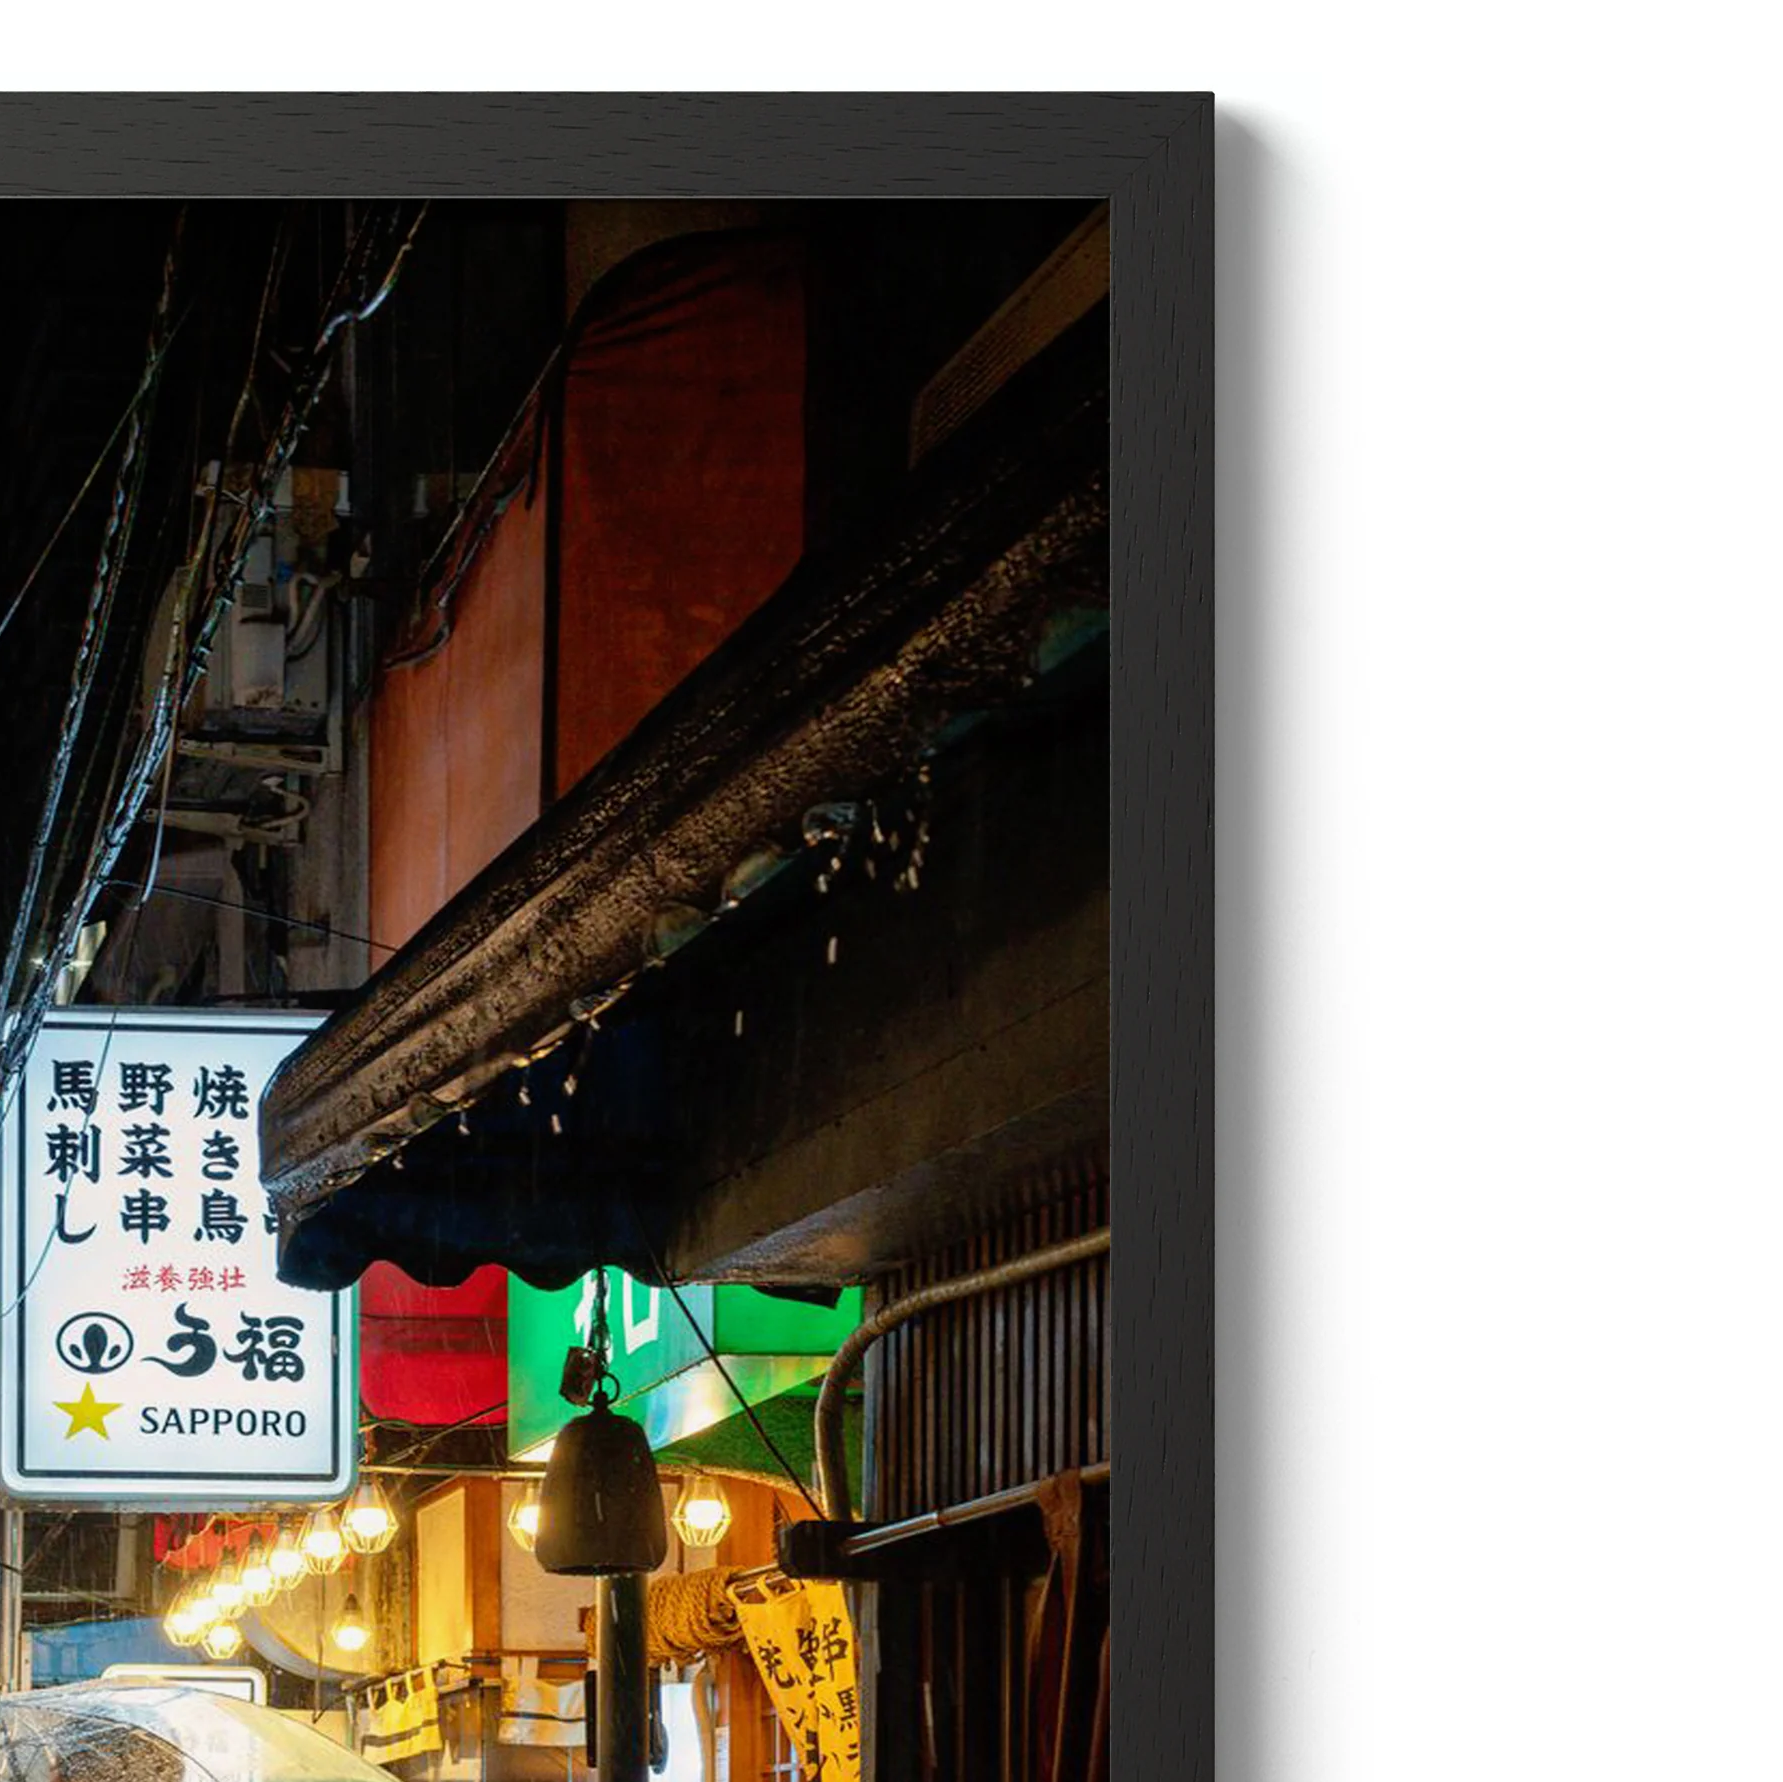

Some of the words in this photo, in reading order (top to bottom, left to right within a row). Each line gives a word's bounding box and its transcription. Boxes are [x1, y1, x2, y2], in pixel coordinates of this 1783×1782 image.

[43, 1059, 102, 1245] 馬刺し
[118, 1061, 175, 1245] 野菜串
[192, 1064, 250, 1245] 焼き鳥
[121, 1265, 247, 1292] 滋養強壮
[140, 1300, 306, 1383] う福
[140, 1406, 307, 1437] SAPPORO
